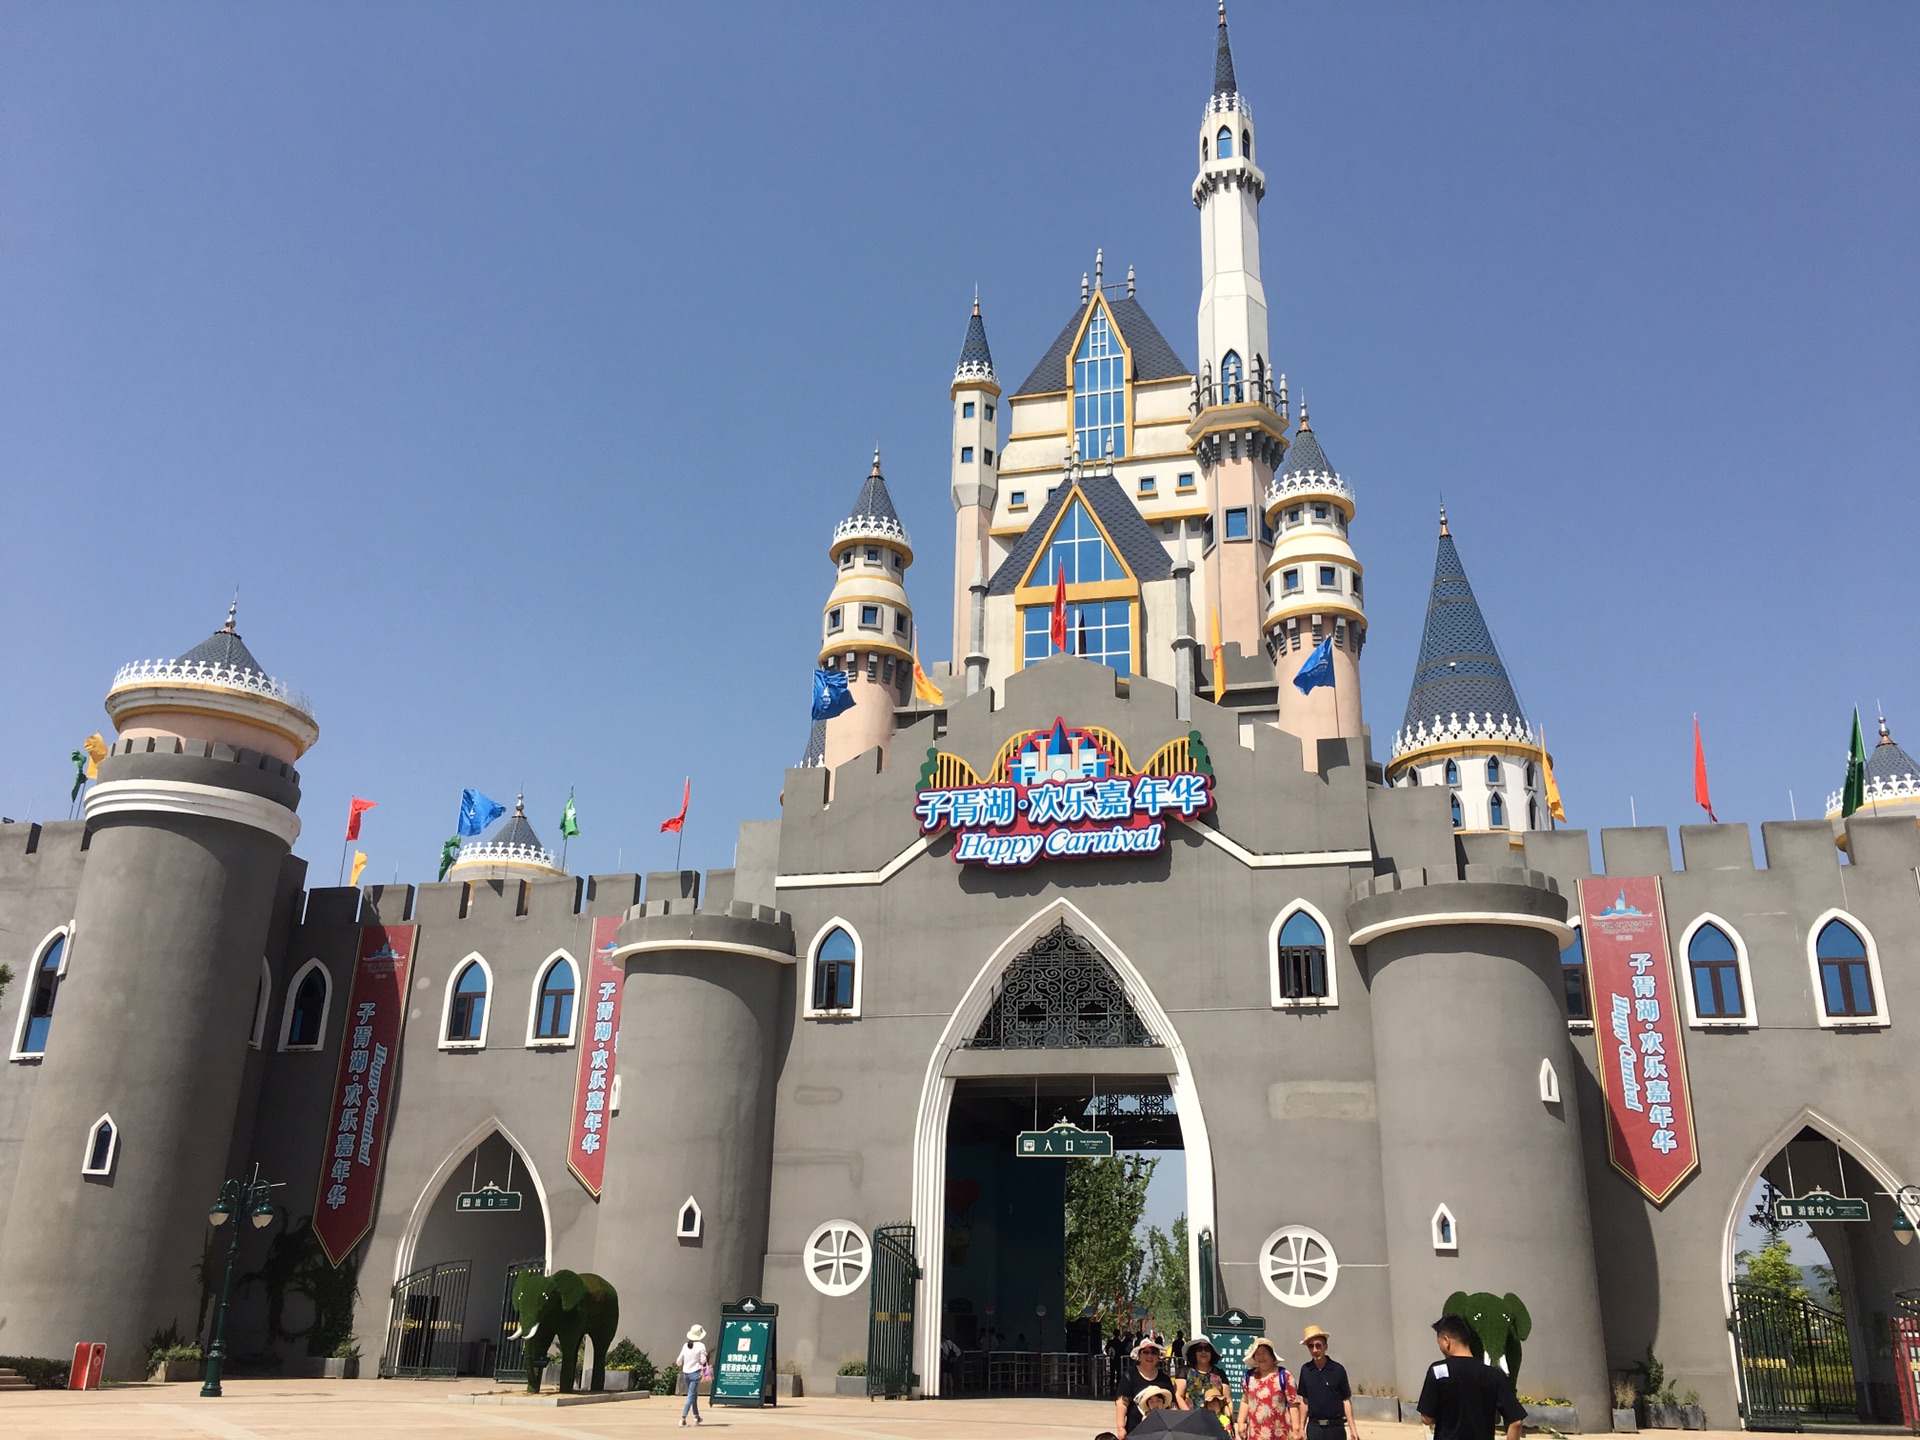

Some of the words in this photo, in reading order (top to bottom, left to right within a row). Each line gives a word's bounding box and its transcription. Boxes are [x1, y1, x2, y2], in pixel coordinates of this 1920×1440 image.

[957, 834, 1041, 866] Happy
[1048, 824, 1161, 852] Carnival
[1611, 993, 1631, 1047] Happy
[367, 1042, 387, 1100] Happy
[1618, 1045, 1643, 1112] Carnival
[358, 1097, 379, 1166] Carnival
[1044, 1139, 1073, 1152] 入口
[1798, 1205, 1834, 1216] 游客中心
